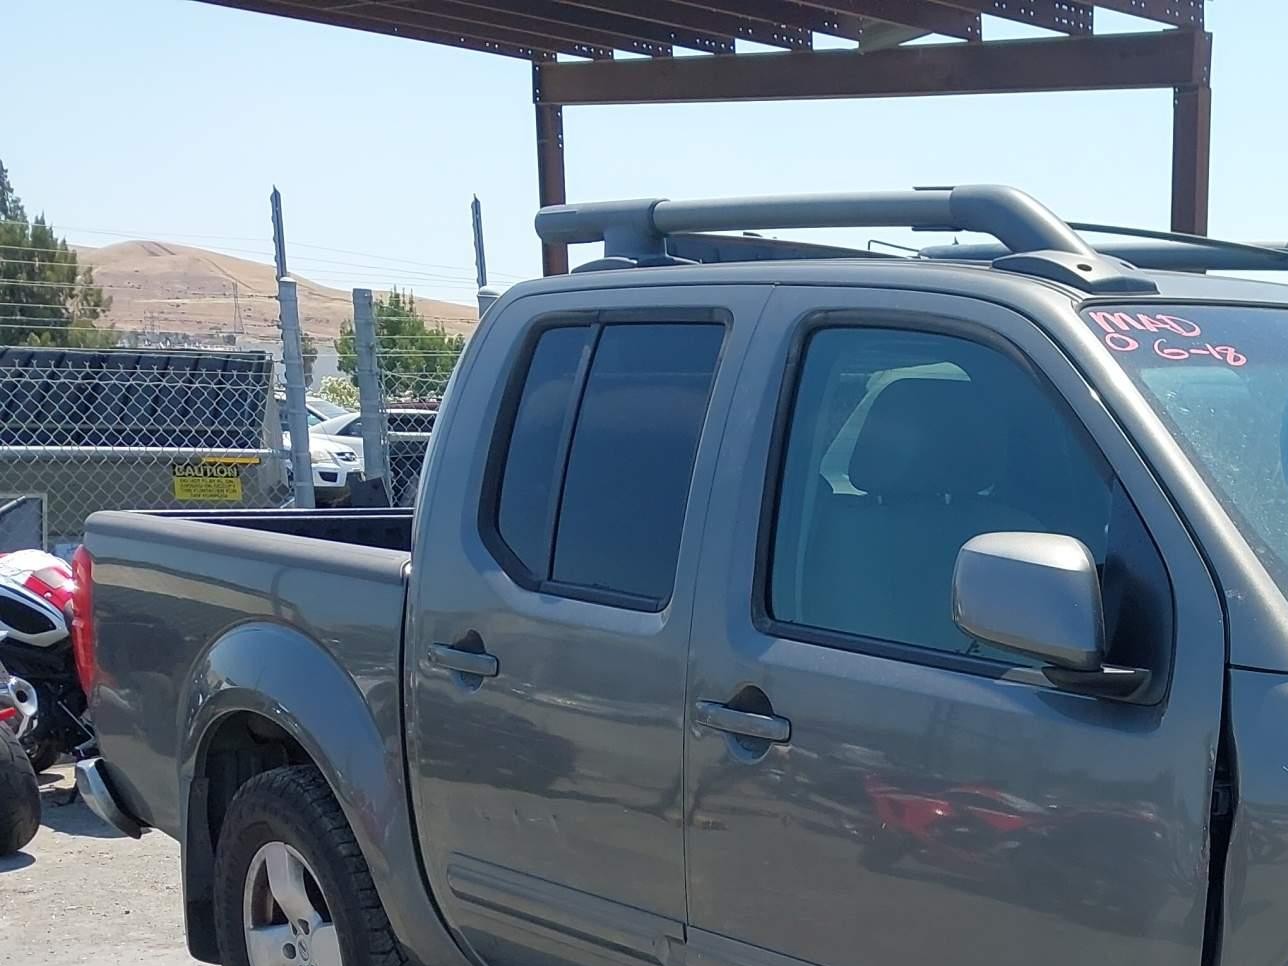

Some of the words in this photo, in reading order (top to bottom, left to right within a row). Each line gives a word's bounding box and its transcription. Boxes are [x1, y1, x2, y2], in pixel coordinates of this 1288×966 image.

[1088, 311, 1201, 337] MAD
[1153, 338, 1248, 366] 6-18
[175, 464, 238, 477] CAUTION
